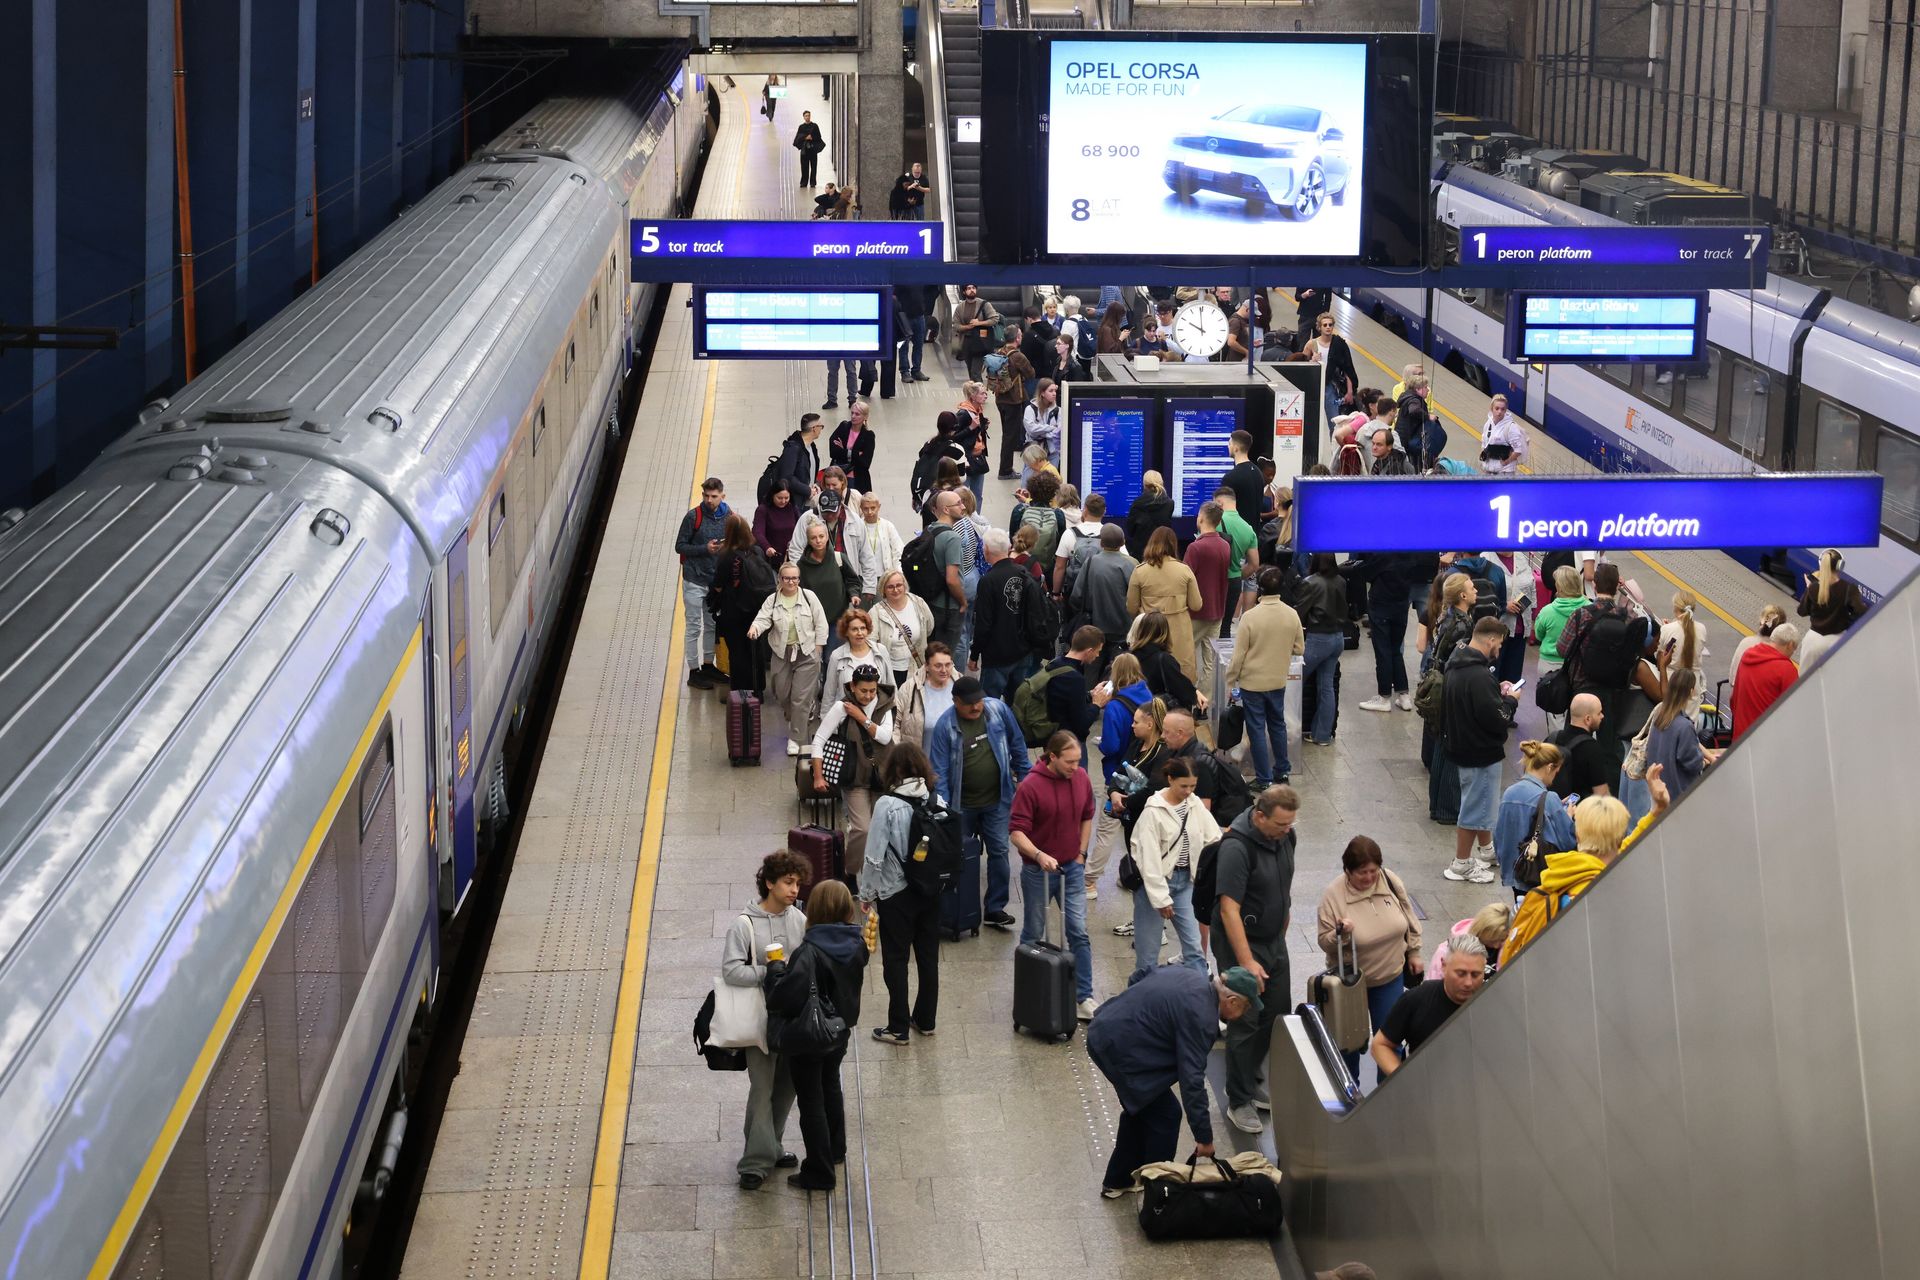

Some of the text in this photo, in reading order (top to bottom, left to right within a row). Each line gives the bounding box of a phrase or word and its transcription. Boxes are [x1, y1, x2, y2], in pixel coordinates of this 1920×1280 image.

[1066, 62, 1199, 79] OPEL CORSA
[1066, 82, 1184, 96] MADE FOR FUN
[1081, 145, 1140, 157] 68 900
[1071, 199, 1090, 221] 8
[641, 226, 724, 253] 5 tor track
[813, 228, 932, 258] peron platform 1
[1473, 232, 1592, 262] 1 peron platform
[1679, 234, 1762, 260] tor track 7
[1559, 299, 1600, 312] Olsztyn
[1641, 420, 1651, 435] PKP
[1651, 426, 1675, 447] INTERCITY
[1489, 494, 1700, 543] 1 peron platform
